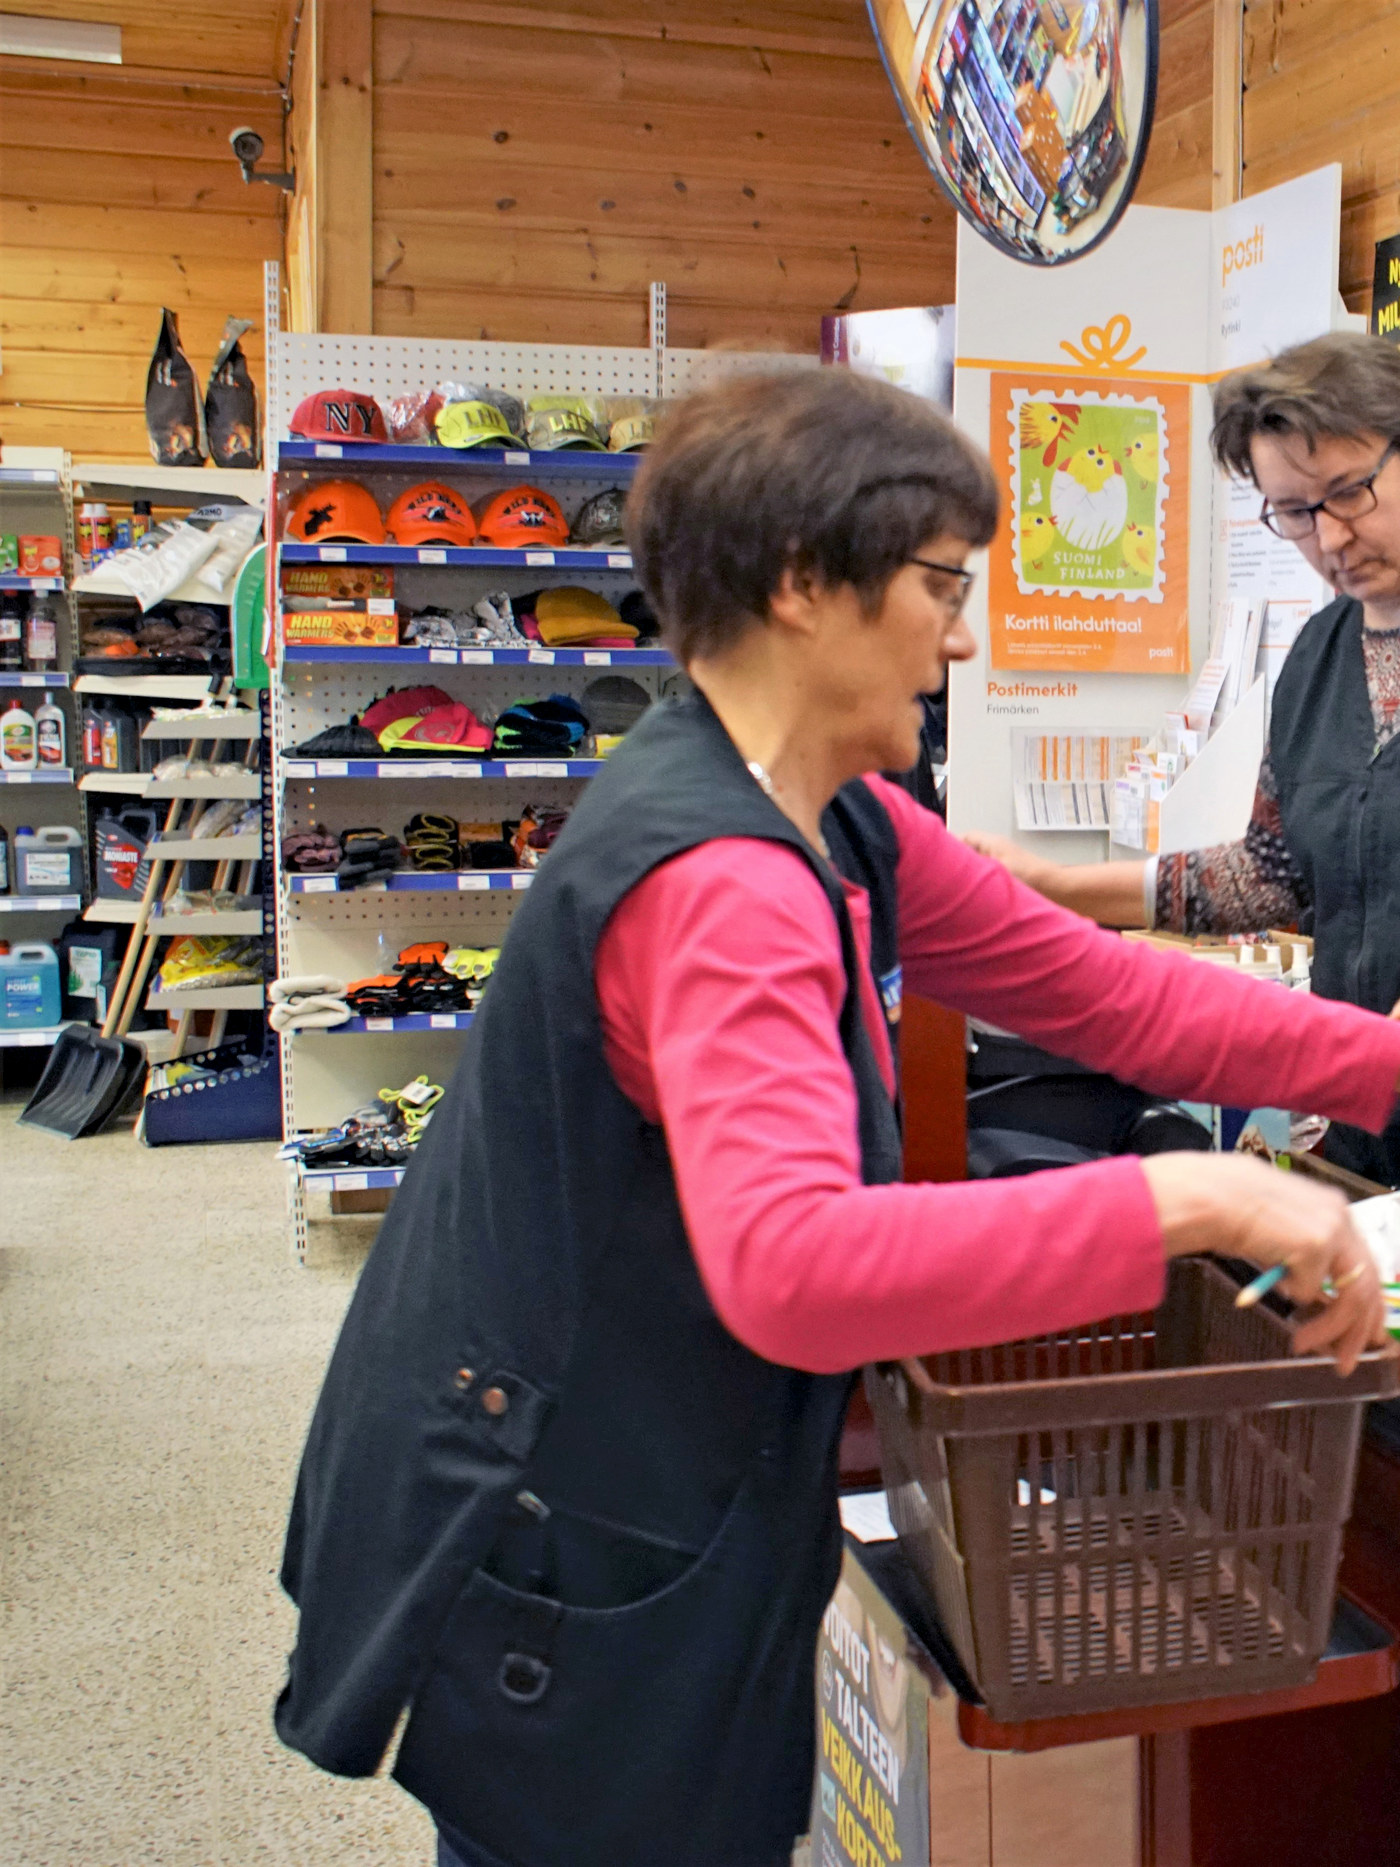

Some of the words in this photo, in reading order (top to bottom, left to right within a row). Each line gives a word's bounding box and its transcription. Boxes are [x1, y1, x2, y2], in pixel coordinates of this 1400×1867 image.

[1222, 223, 1265, 288] posti
[323, 401, 376, 435] NY
[1053, 551, 1102, 566] SUOMI
[290, 571, 329, 583] HAND
[1060, 567, 1126, 581] FINLAND
[291, 614, 333, 629] HAND
[1005, 614, 1049, 632] Kortti
[1053, 615, 1143, 634] ilahduttaa!
[286, 628, 335, 639] WARMERS
[1149, 646, 1174, 660] posti
[987, 682, 1078, 698] Postimerkit
[986, 703, 1040, 716] Frimärken
[104, 850, 138, 864] MONIASTE
[6, 981, 41, 992] POWER
[835, 1669, 899, 1806] TALTEEN
